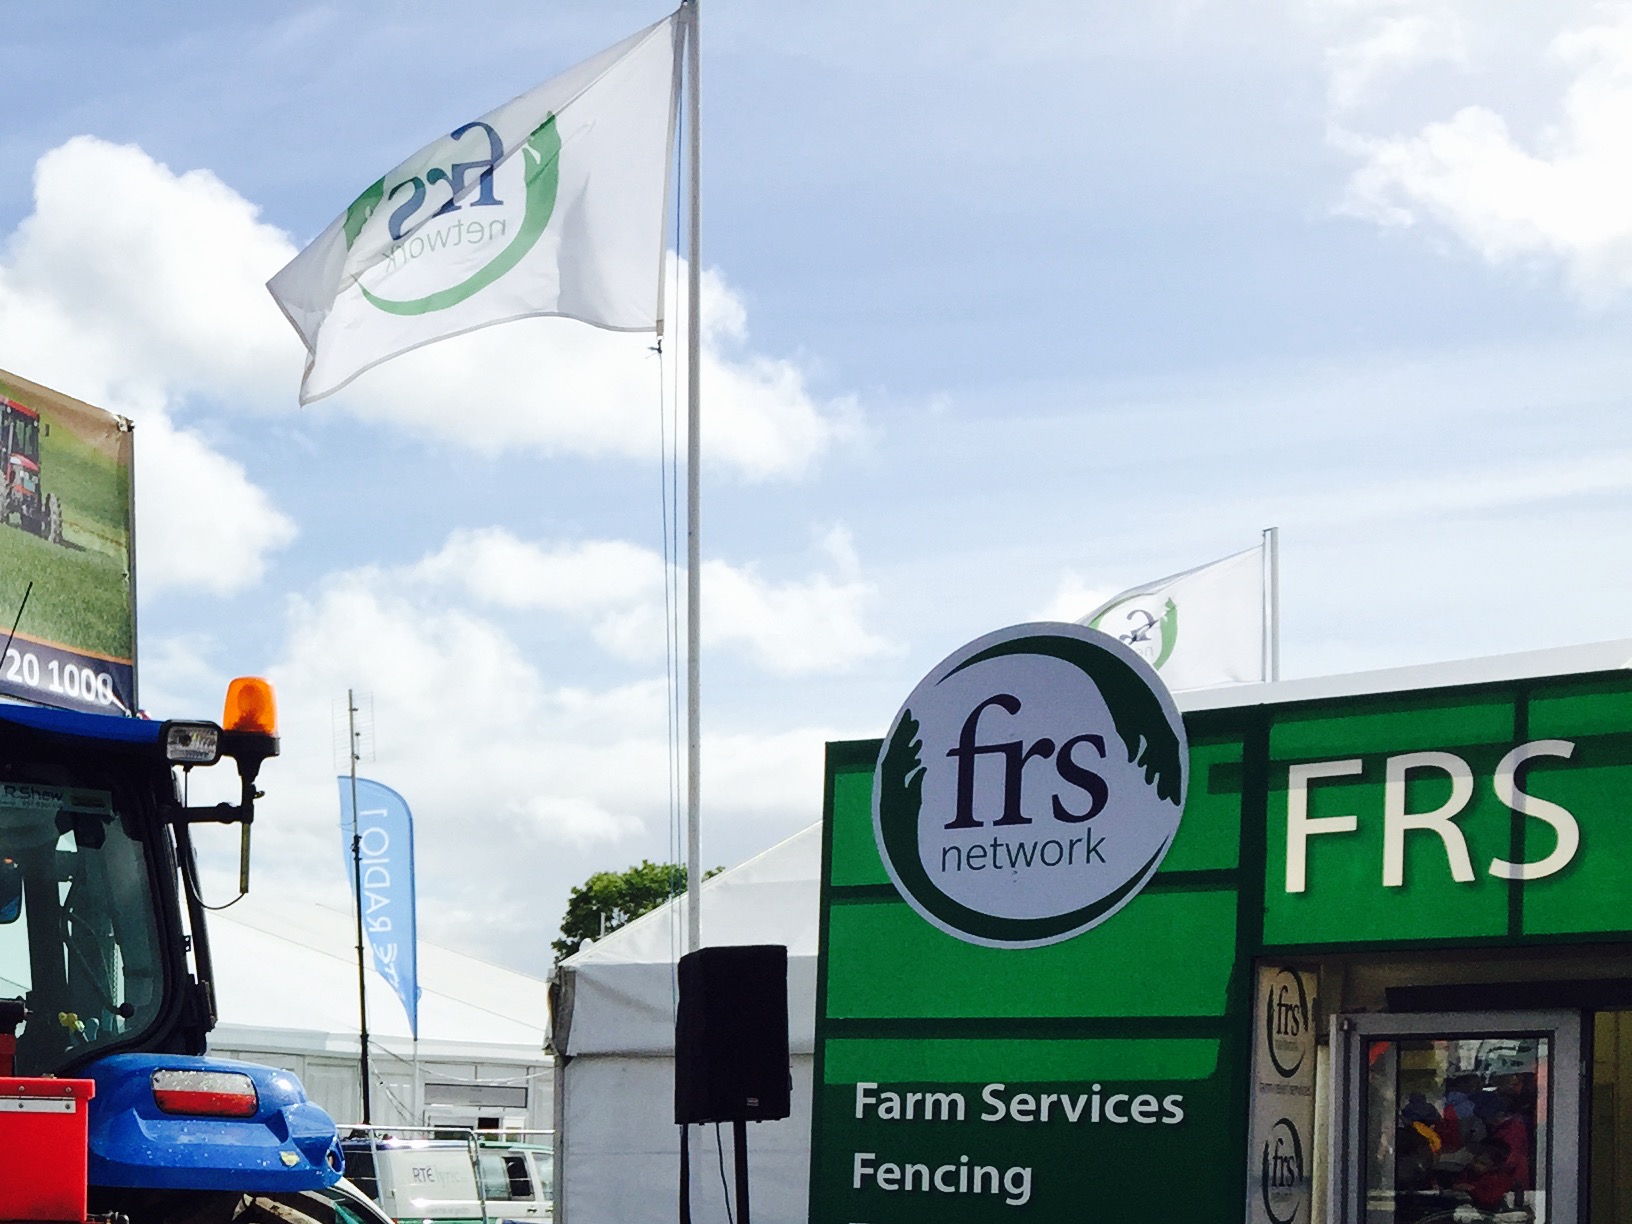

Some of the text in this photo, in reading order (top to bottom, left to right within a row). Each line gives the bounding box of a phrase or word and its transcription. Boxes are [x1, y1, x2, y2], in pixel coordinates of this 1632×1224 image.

[6, 648, 40, 687] 20
[48, 660, 114, 706] 1000
[944, 694, 1109, 829] frs
[1285, 739, 1580, 893] FRS
[942, 827, 1107, 872] network
[1276, 985, 1300, 1036] frs
[855, 1082, 1184, 1124] Farm Services
[853, 1153, 1033, 1206] Fencing
[1272, 1138, 1296, 1188] frs
